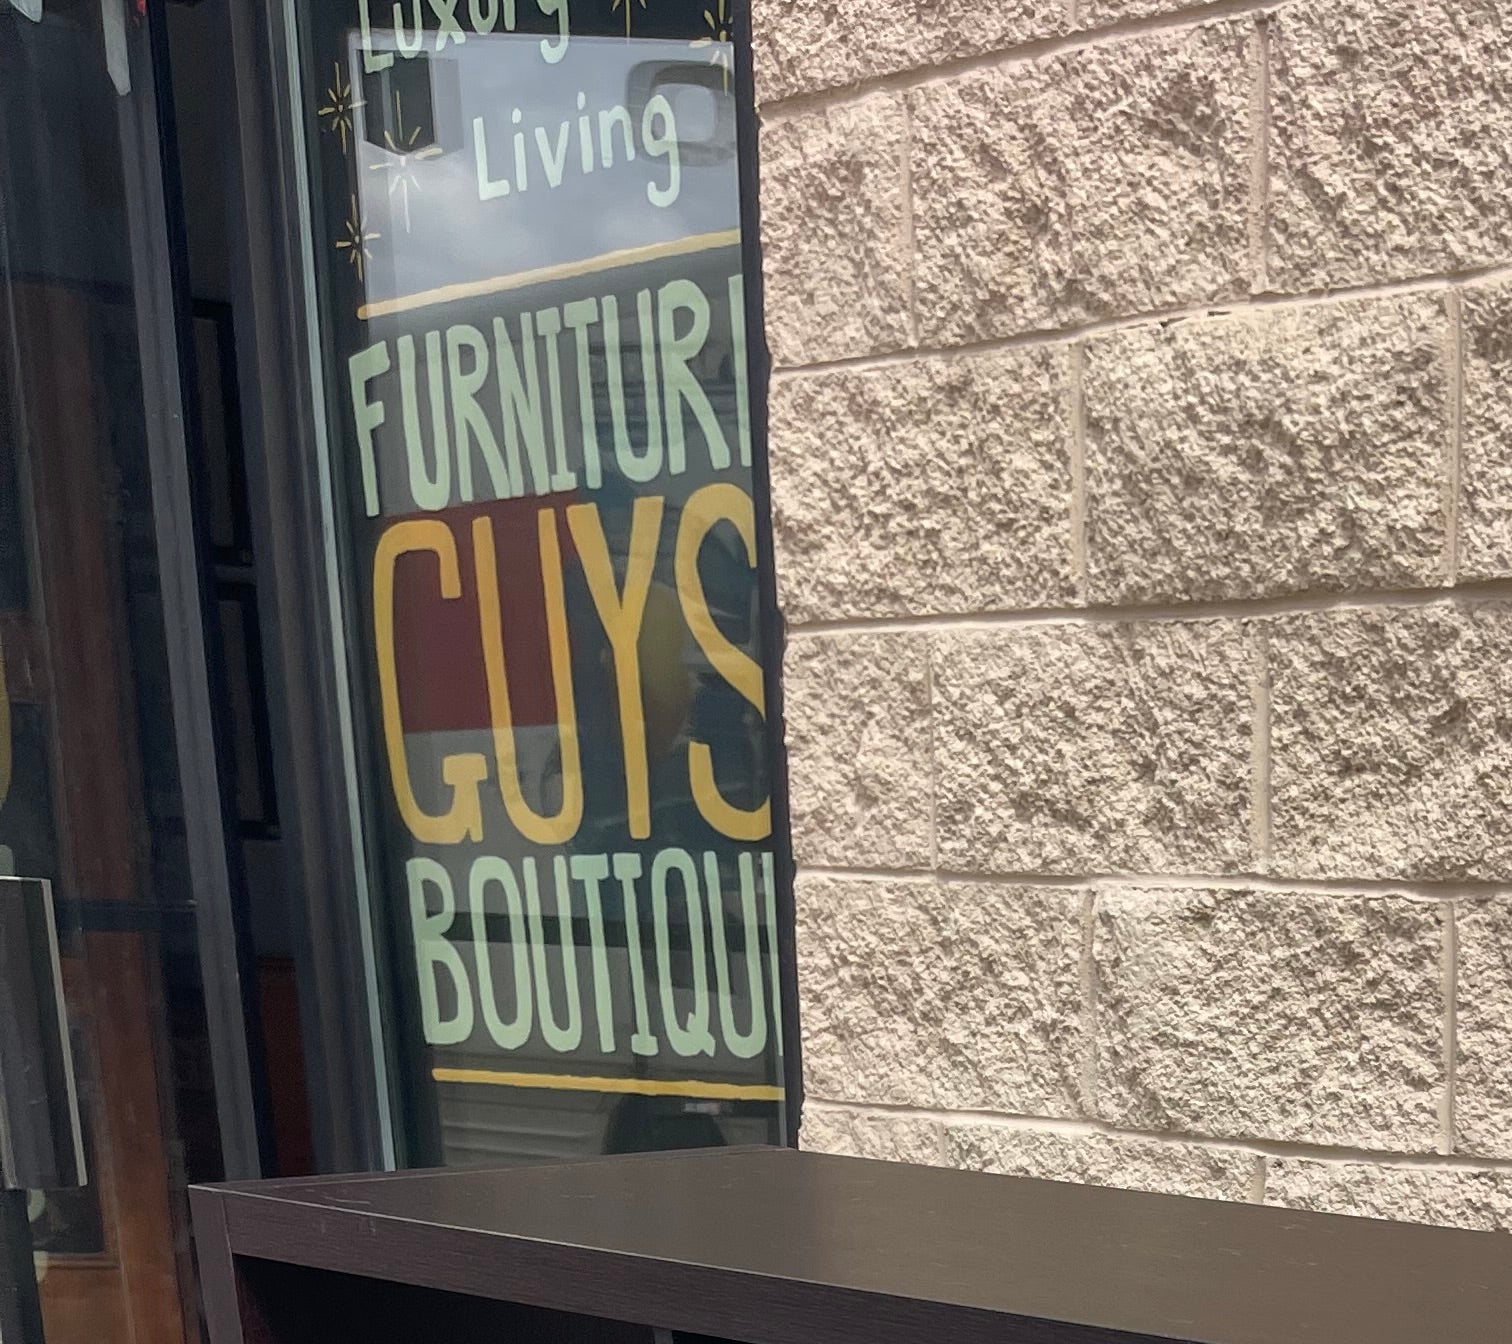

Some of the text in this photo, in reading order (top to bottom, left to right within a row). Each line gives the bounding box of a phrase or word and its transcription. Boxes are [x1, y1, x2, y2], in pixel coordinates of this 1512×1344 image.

[473, 92, 681, 207] Living
[373, 483, 772, 844] GUYS
[406, 848, 783, 1058] BOUTIQU
